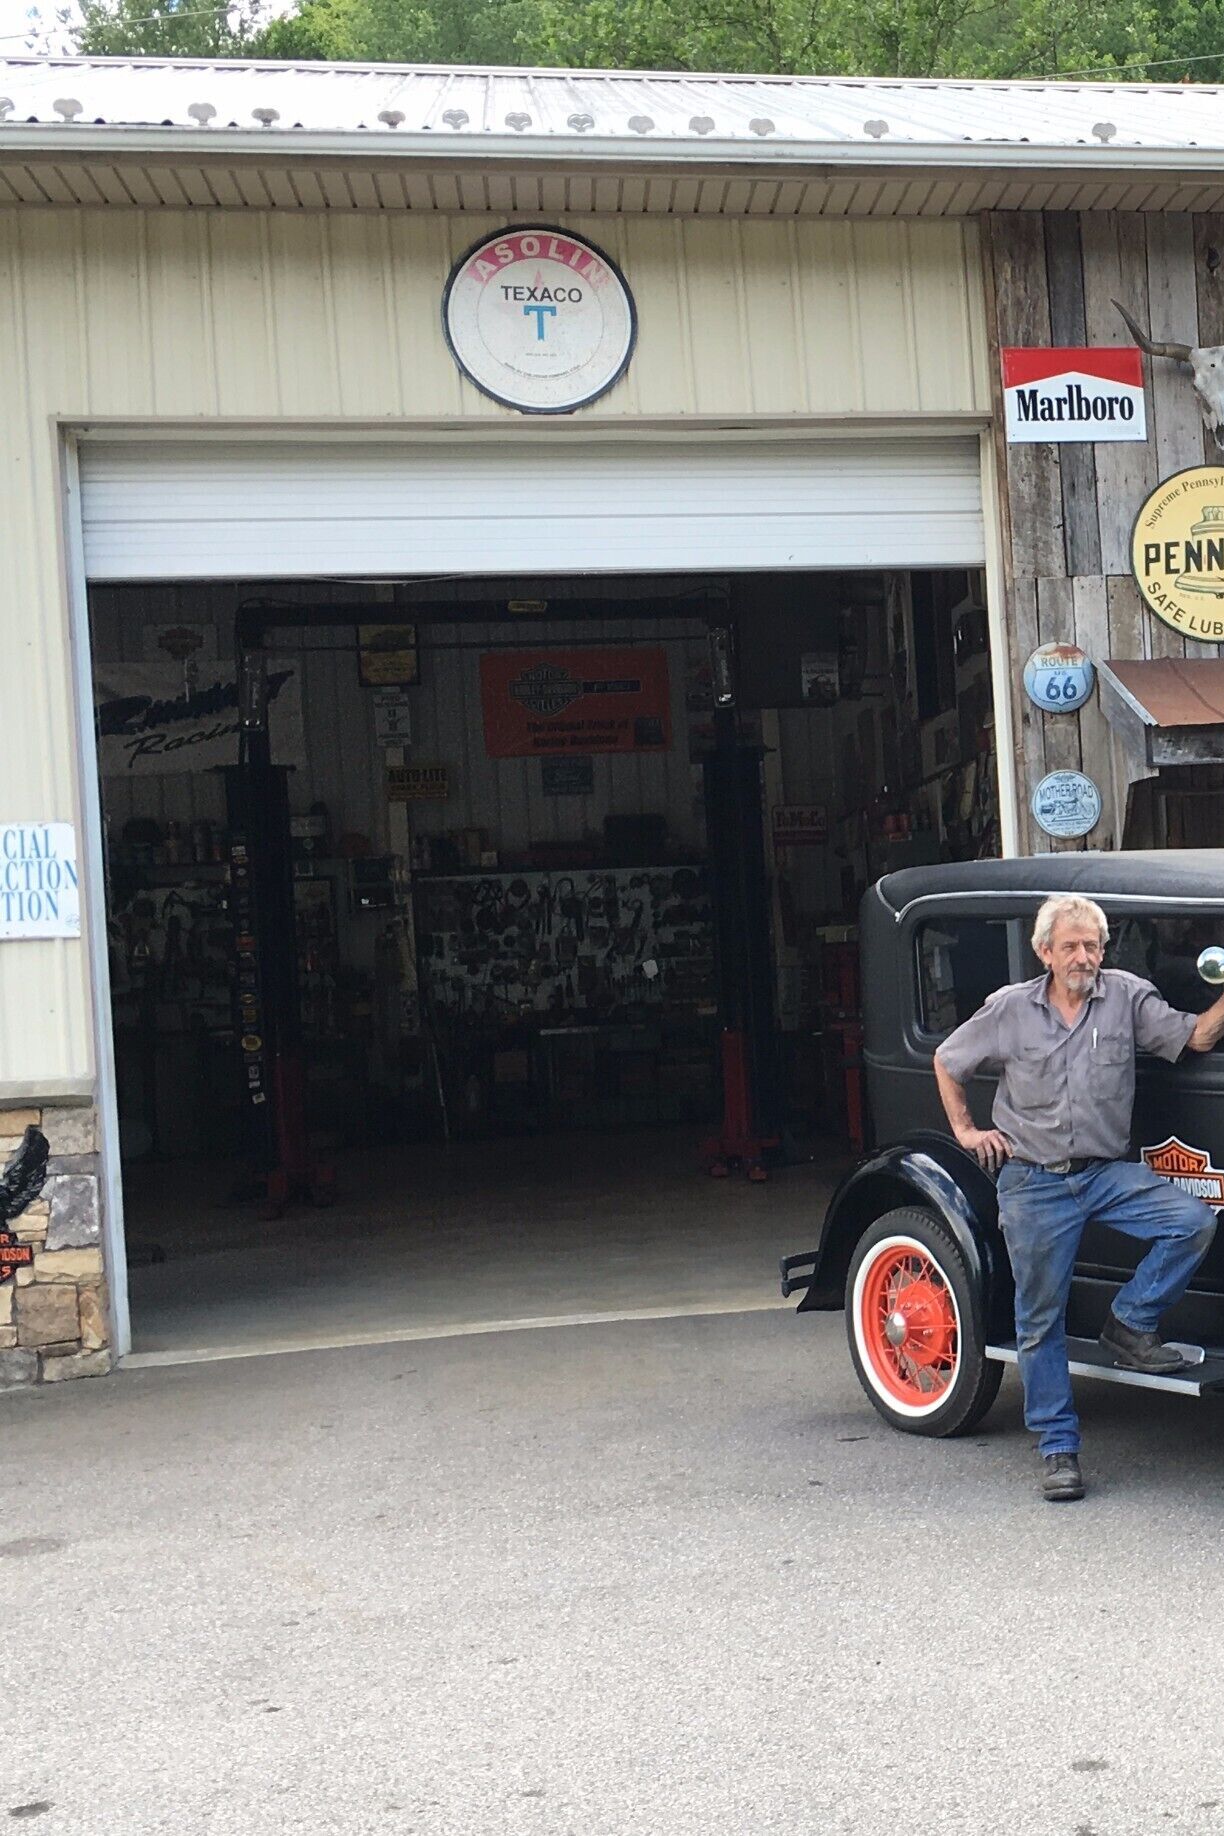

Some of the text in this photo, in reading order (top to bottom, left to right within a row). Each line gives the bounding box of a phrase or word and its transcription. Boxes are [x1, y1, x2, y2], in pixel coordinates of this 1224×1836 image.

[501, 285, 582, 303] TEXACO
[524, 305, 557, 341] T
[1016, 384, 1134, 421] Marlboro
[1145, 488, 1181, 529] Supreme
[1147, 581, 1186, 623] SAFE
[1041, 657, 1078, 667] ROUTE
[1045, 676, 1078, 700] 66
[124, 722, 242, 767] Racin
[1040, 783, 1093, 800] MOTHER ROAD
[0, 860, 78, 891] CTION
[1153, 1149, 1198, 1171] MOTOR
